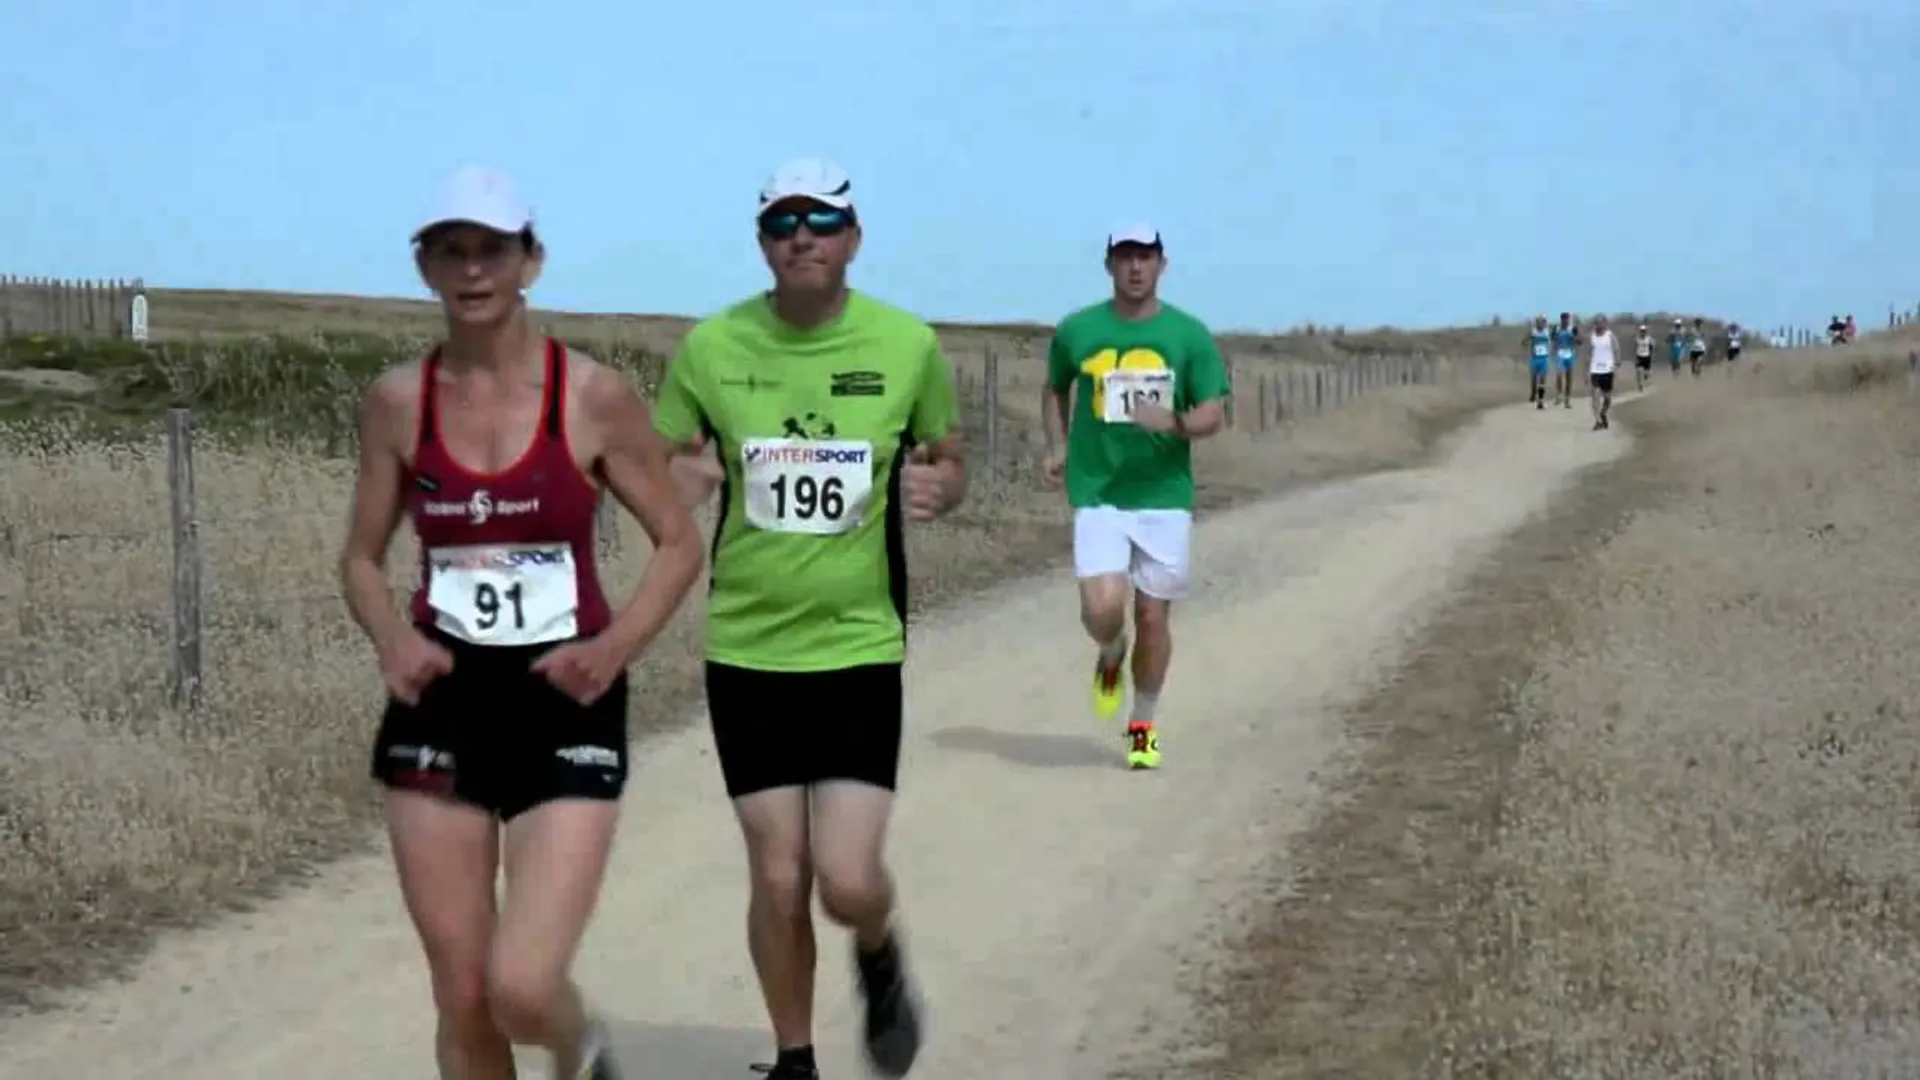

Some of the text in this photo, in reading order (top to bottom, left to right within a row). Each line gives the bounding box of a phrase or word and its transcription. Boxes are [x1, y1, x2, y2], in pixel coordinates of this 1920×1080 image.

[763, 448, 866, 463] INTERSPORT
[770, 474, 844, 520] 196
[474, 582, 524, 629] 91
